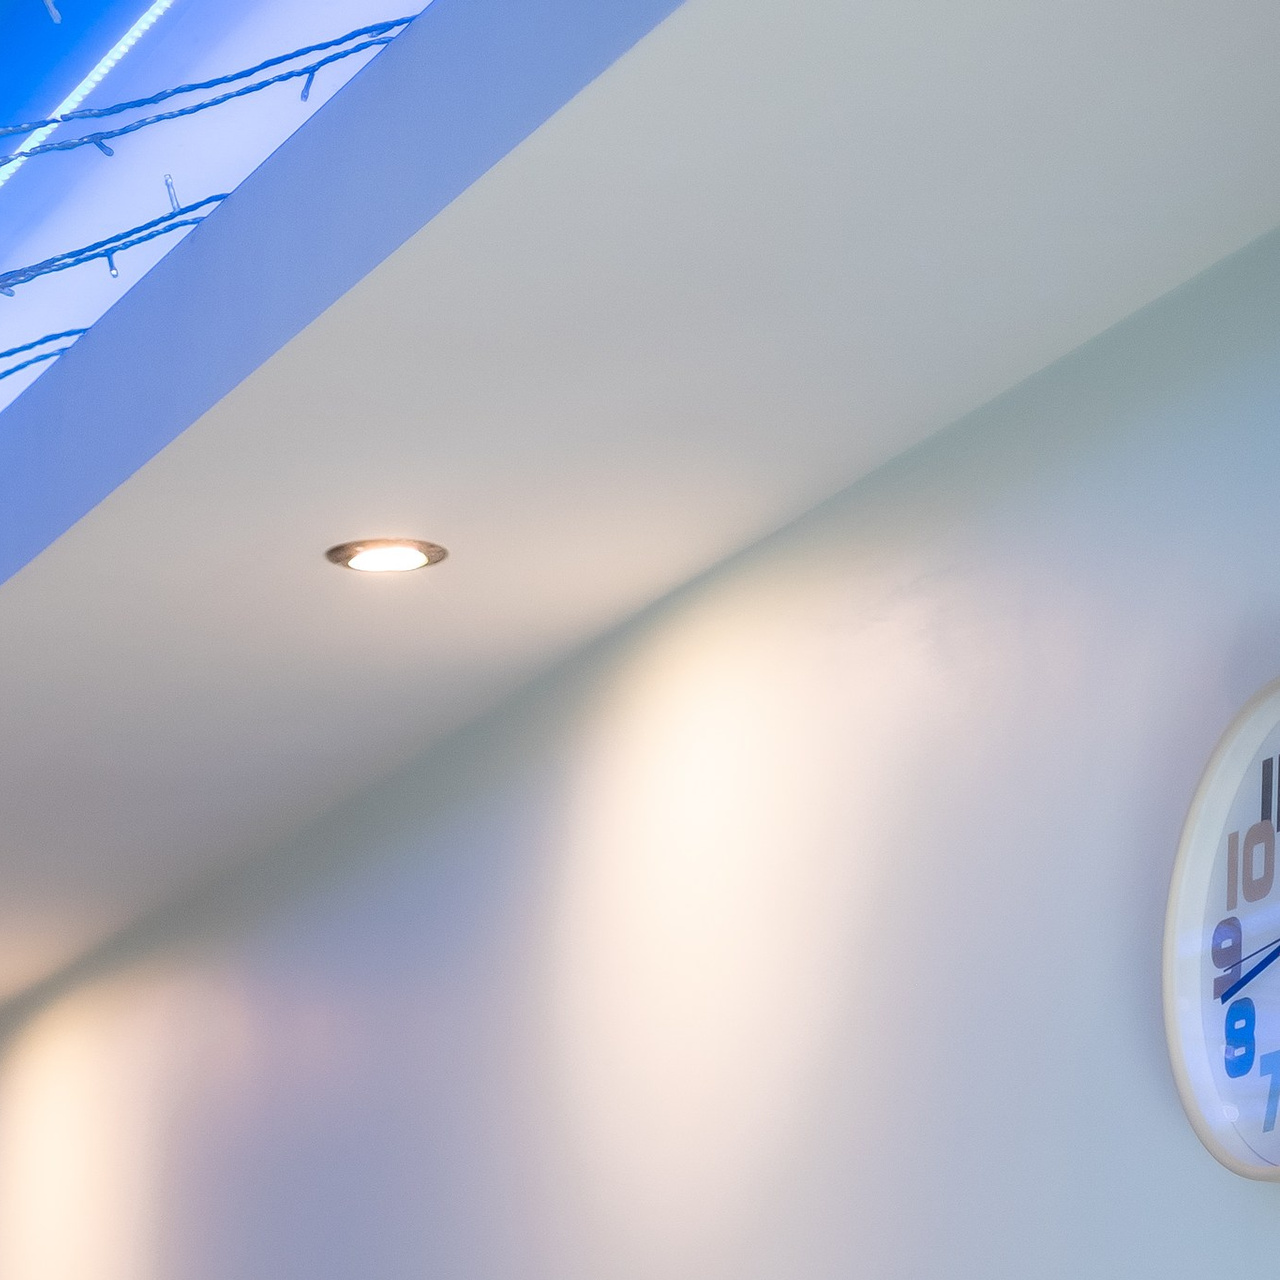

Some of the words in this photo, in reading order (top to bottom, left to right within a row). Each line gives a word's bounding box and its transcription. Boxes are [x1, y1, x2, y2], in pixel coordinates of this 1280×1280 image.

[1261, 756, 1280, 832] 1
[1226, 818, 1275, 912] 10
[1211, 916, 1242, 1000] 9
[1224, 996, 1256, 1079] 8
